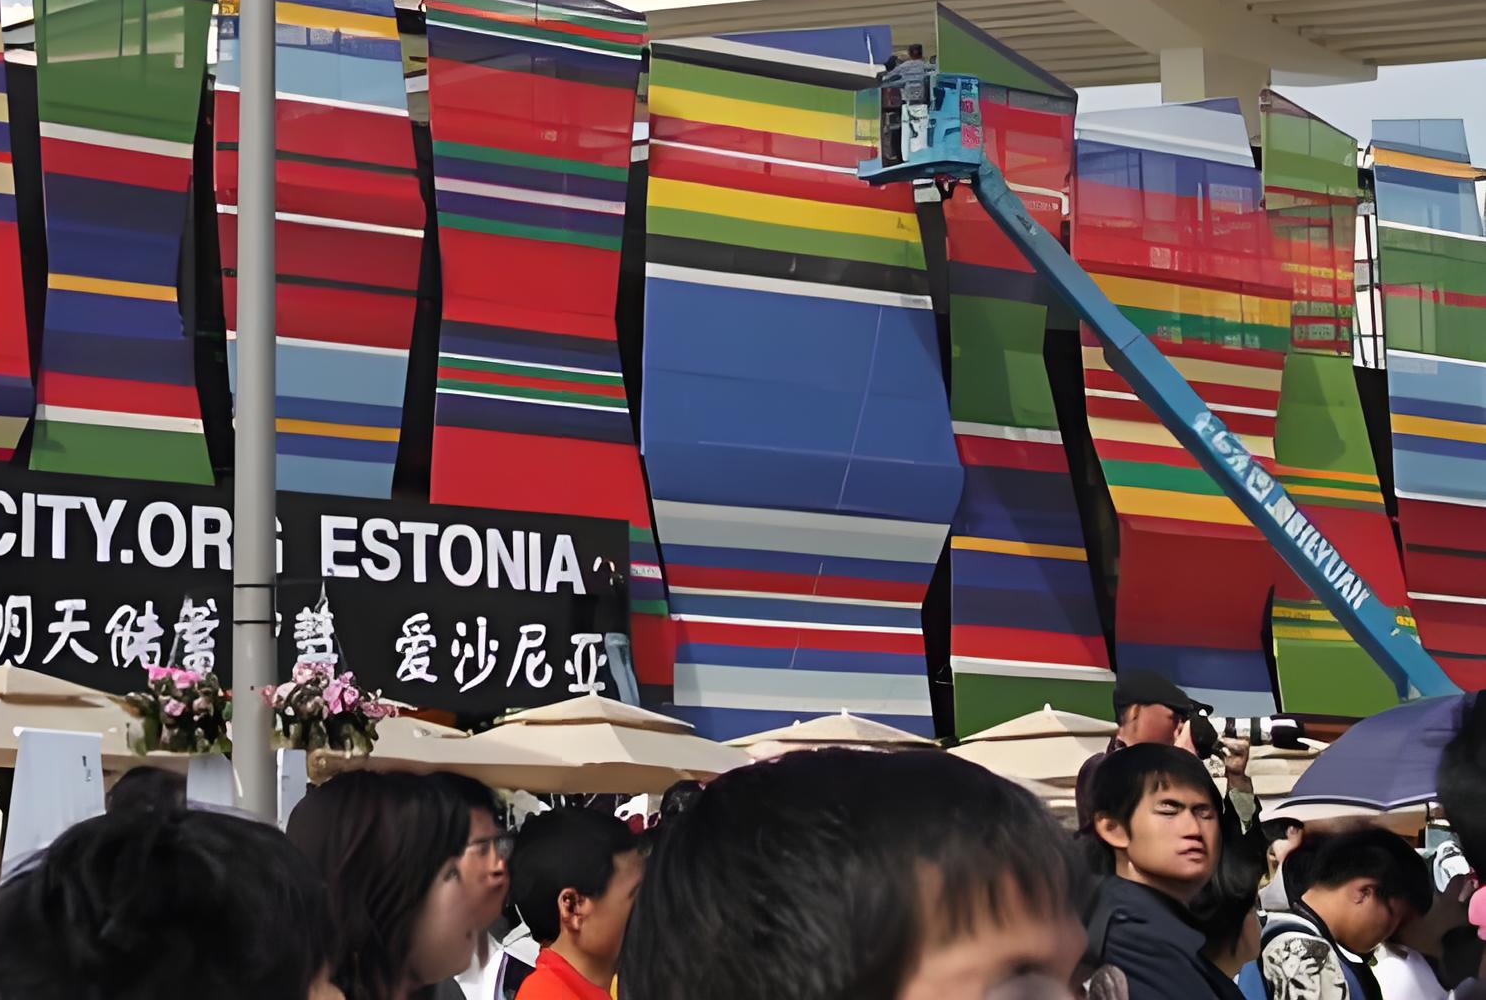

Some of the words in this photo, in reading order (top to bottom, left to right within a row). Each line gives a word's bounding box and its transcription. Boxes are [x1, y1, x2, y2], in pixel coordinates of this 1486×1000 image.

[320, 514, 587, 596] ESTONIA
[395, 611, 607, 694] 爱沙尼亚
